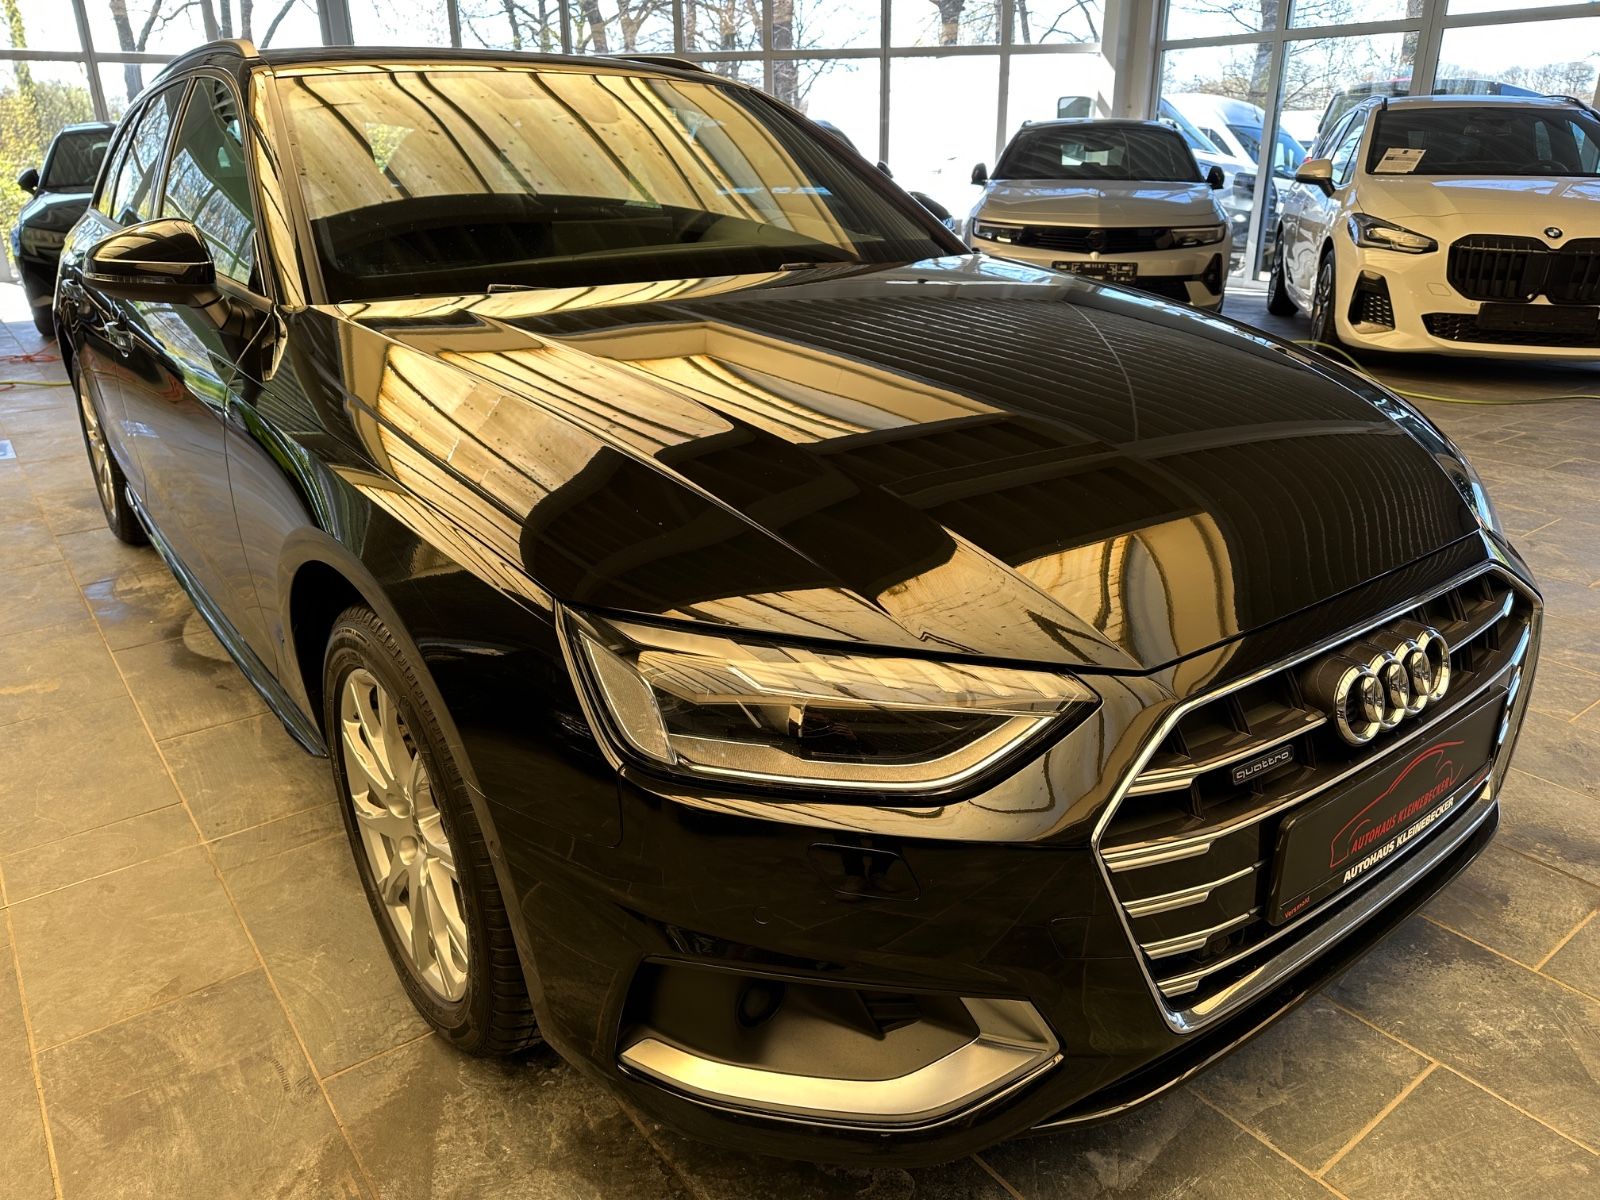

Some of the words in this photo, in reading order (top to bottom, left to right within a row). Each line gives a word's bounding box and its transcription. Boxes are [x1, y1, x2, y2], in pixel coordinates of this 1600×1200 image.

[1236, 751, 1289, 779] quattro
[1343, 840, 1395, 884] AUTOHAUS
[1396, 797, 1454, 849] KLEINEBECKER
[1352, 814, 1396, 853] AUTOHAUS
[1397, 777, 1451, 823] KLEINEBECKER
